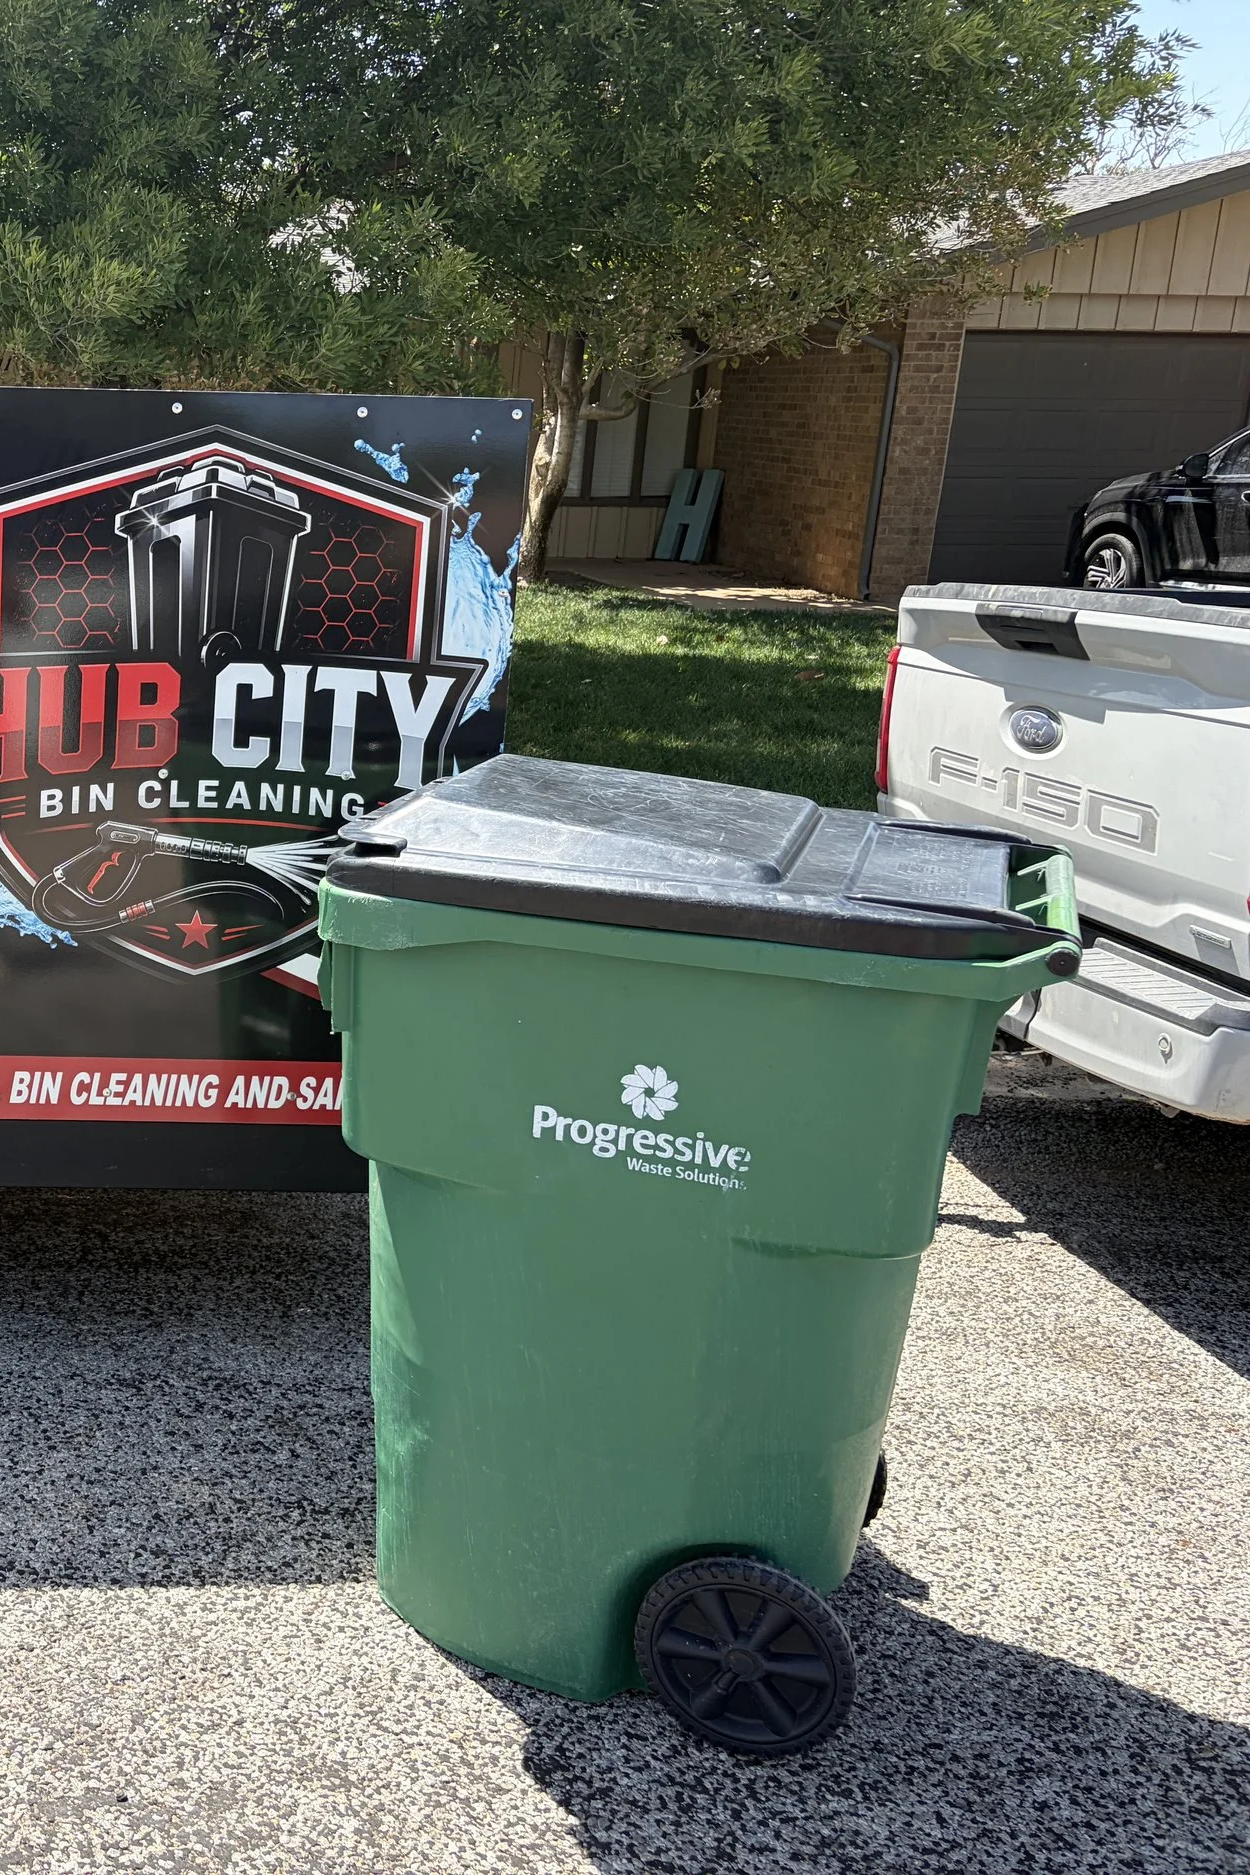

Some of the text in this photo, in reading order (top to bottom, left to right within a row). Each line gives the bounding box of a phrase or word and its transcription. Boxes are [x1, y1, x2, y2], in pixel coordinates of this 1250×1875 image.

[212, 662, 457, 790] CITY
[1016, 714, 1048, 743] Ford
[39, 779, 365, 822] BIN CLEANING
[928, 745, 1161, 856] F-150
[9, 1071, 61, 1105] BIN
[70, 1072, 220, 1108] CLEANING
[224, 1075, 290, 1109] AND
[532, 1105, 751, 1172] Progressive
[626, 1156, 672, 1178] Waste
